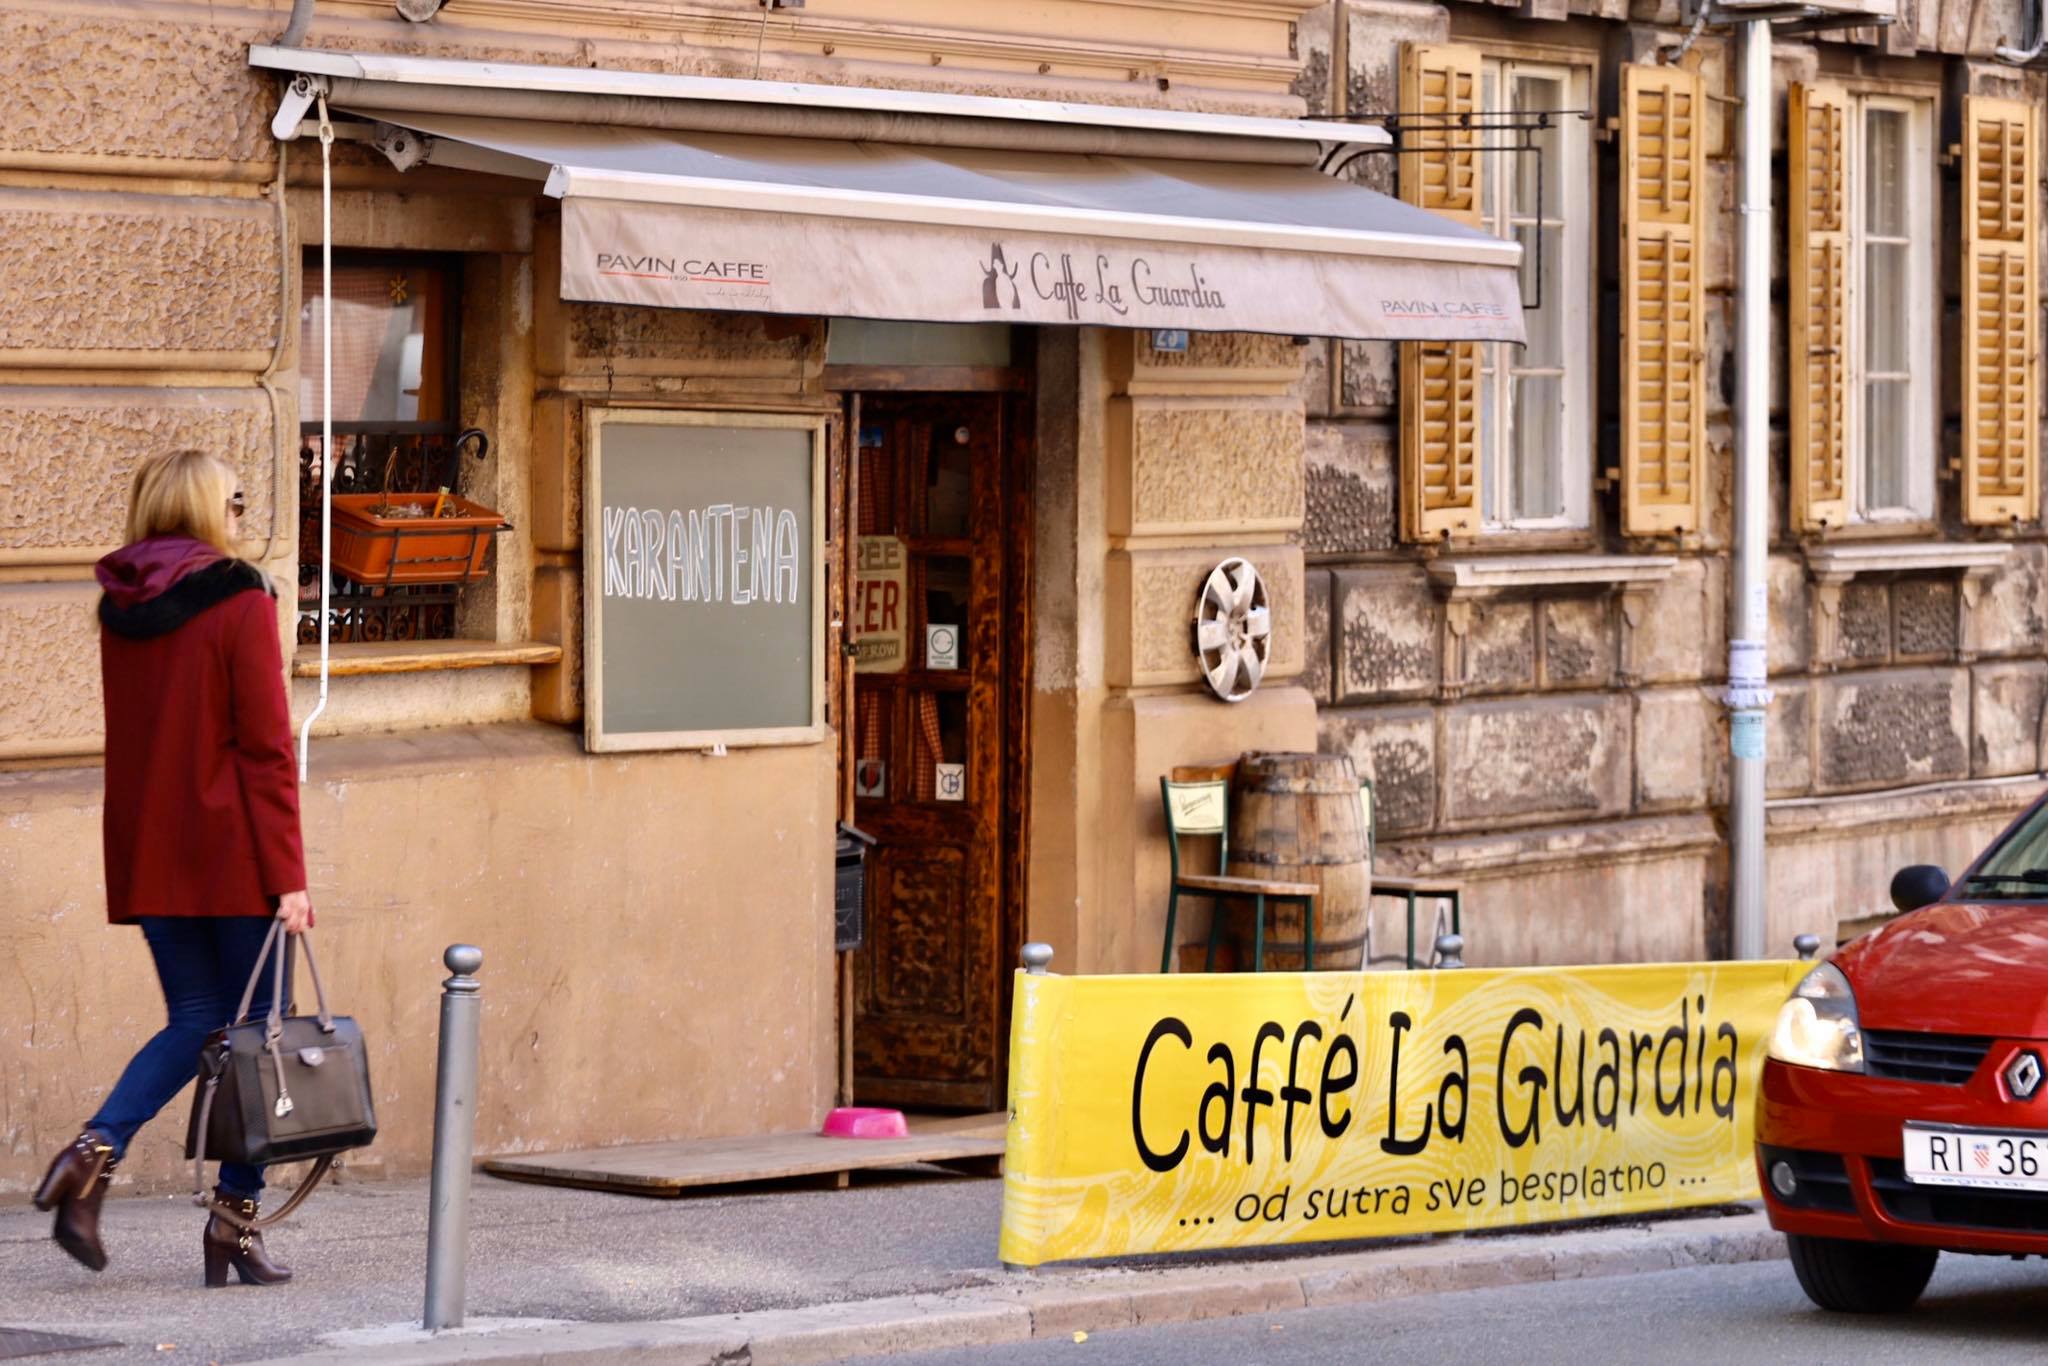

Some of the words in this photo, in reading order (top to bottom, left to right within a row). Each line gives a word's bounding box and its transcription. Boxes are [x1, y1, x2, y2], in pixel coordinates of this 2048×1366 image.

[597, 253, 675, 273] PAVIN
[1031, 252, 1088, 320] Caffe
[1096, 255, 1128, 315] La
[1131, 258, 1225, 309] Guardia
[1380, 301, 1438, 314] PAVIN
[603, 504, 799, 604] KARANTENA
[1132, 993, 1358, 1172] Caffé
[1379, 1011, 1469, 1155] La
[1497, 994, 1738, 1149] Guardia
[1930, 1136, 1963, 1172] RI
[1997, 1139, 2048, 1176] 36
[1234, 1186, 1290, 1222] od
[1303, 1184, 1411, 1220] sutra
[1425, 1175, 1486, 1211] sve
[1500, 1161, 1666, 1206] besplatno
